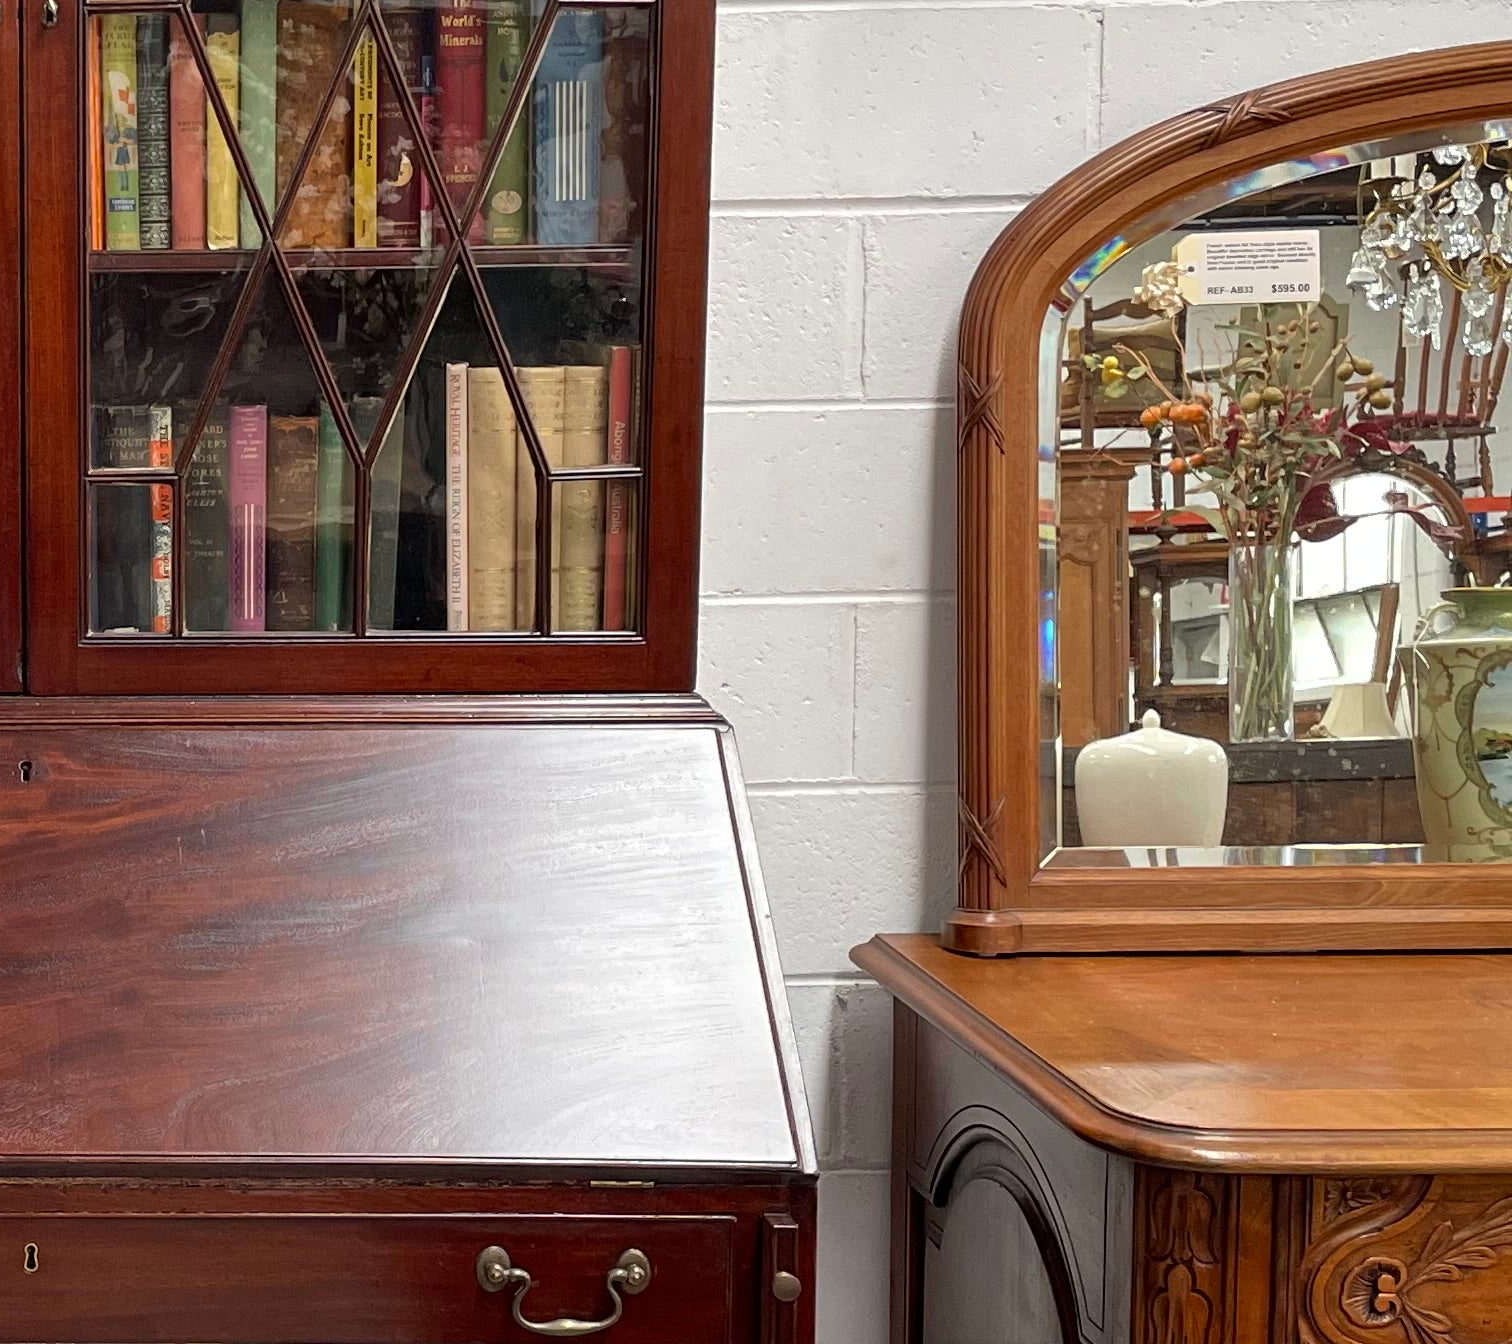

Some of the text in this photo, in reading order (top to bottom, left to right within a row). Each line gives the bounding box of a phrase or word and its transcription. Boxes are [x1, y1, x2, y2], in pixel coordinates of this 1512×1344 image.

[440, 14, 482, 28] World's
[439, 34, 483, 47] Minerals
[365, 153, 373, 167] Art
[1271, 283, 1311, 294] $595.00
[449, 374, 462, 407] ROYAL
[159, 425, 169, 448] THE
[449, 407, 462, 457] HERITAGE
[451, 463, 462, 486] THE
[161, 494, 171, 528] NAVY
[451, 487, 462, 521] REIGN
[610, 484, 625, 536] Australia
[451, 522, 461, 537] OF
[451, 538, 462, 594] ELIZABETH
